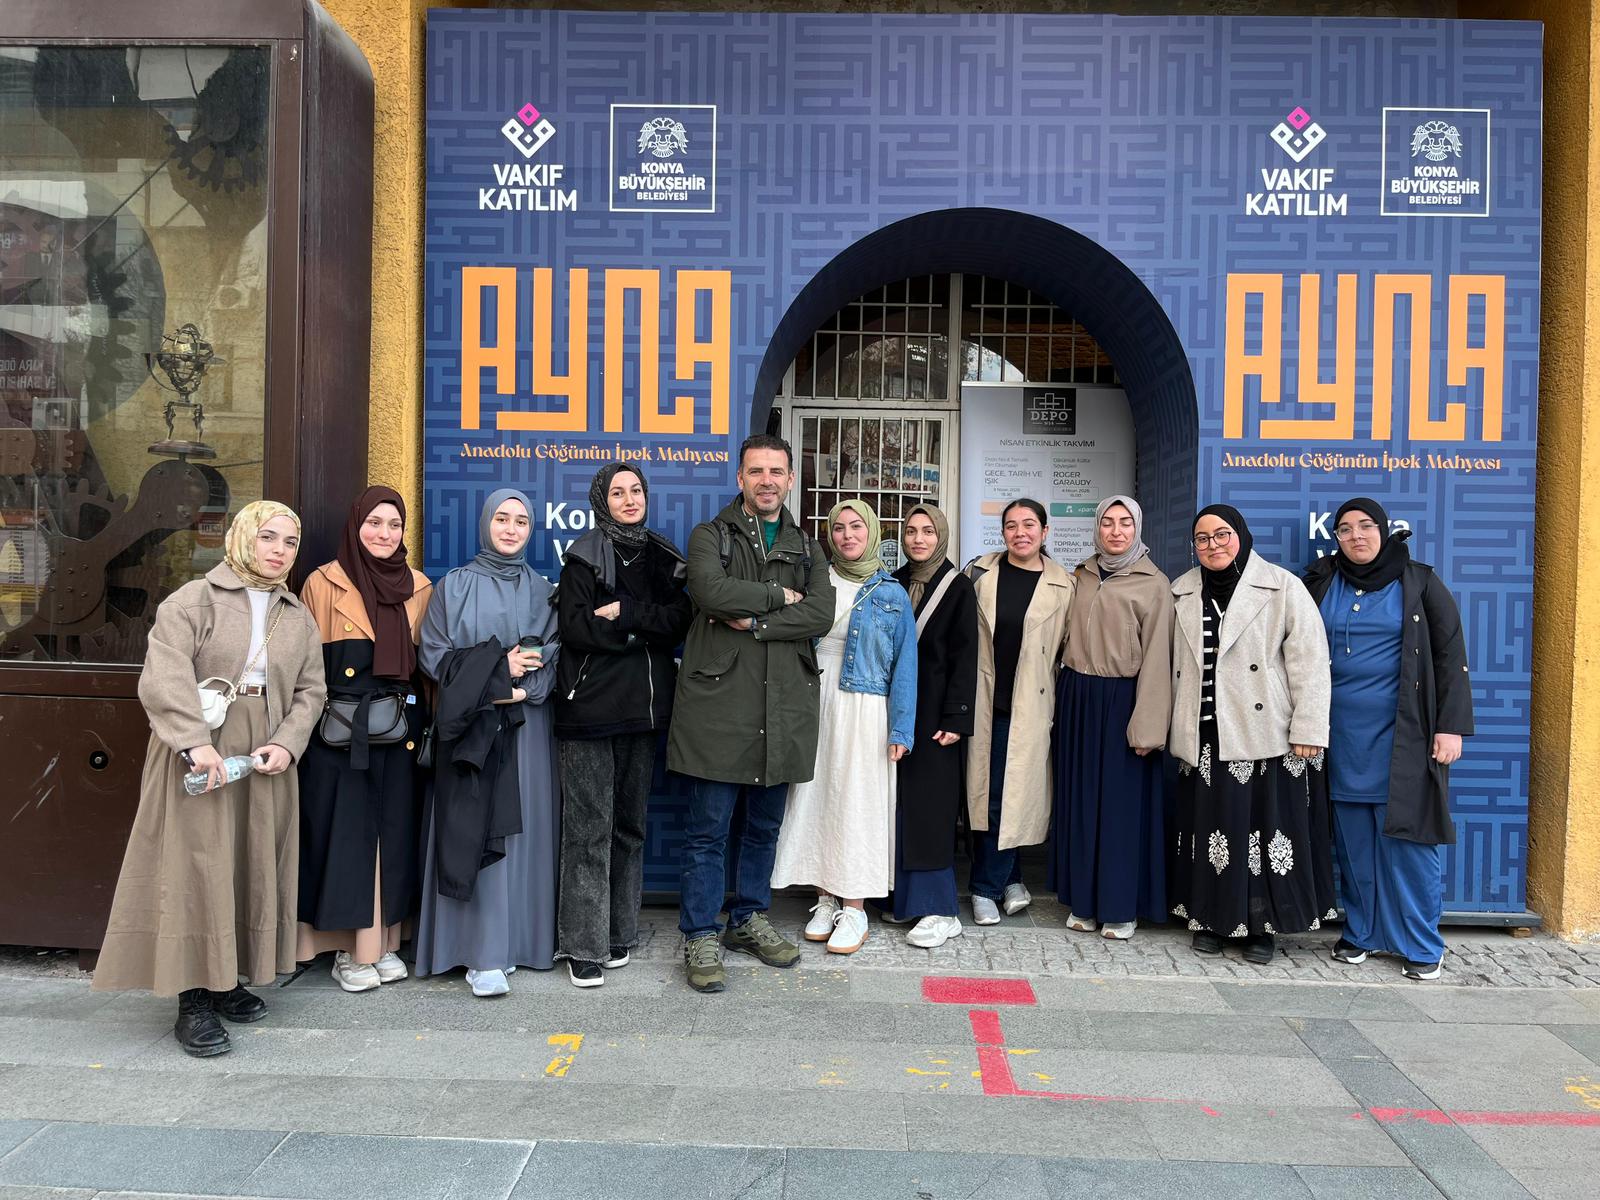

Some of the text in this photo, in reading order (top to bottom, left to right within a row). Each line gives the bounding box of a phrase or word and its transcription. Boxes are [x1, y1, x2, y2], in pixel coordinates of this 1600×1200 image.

[493, 164, 563, 186] VAKIF
[641, 162, 684, 175] KONYA
[1414, 166, 1458, 178] KONYA
[619, 174, 706, 192] BÜYÜKŞEHİR
[1261, 168, 1334, 191] VAKIF
[1391, 178, 1480, 196] BÜYÜKŞEHİR
[479, 189, 577, 211] KATILIM
[636, 191, 688, 201] BELEDİYESİ
[1246, 193, 1348, 216] KATILIM
[1409, 195, 1462, 205] BELEDİYESİ
[1030, 410, 1068, 421] DEPO
[1000, 439, 1095, 448] NİSAN ETKİNLİK TAKVİMİ
[460, 442, 729, 464] Anadolu Göğünün İpek Mahyası
[1222, 450, 1502, 473] Anadolu Göğünün İpek Mahyası
